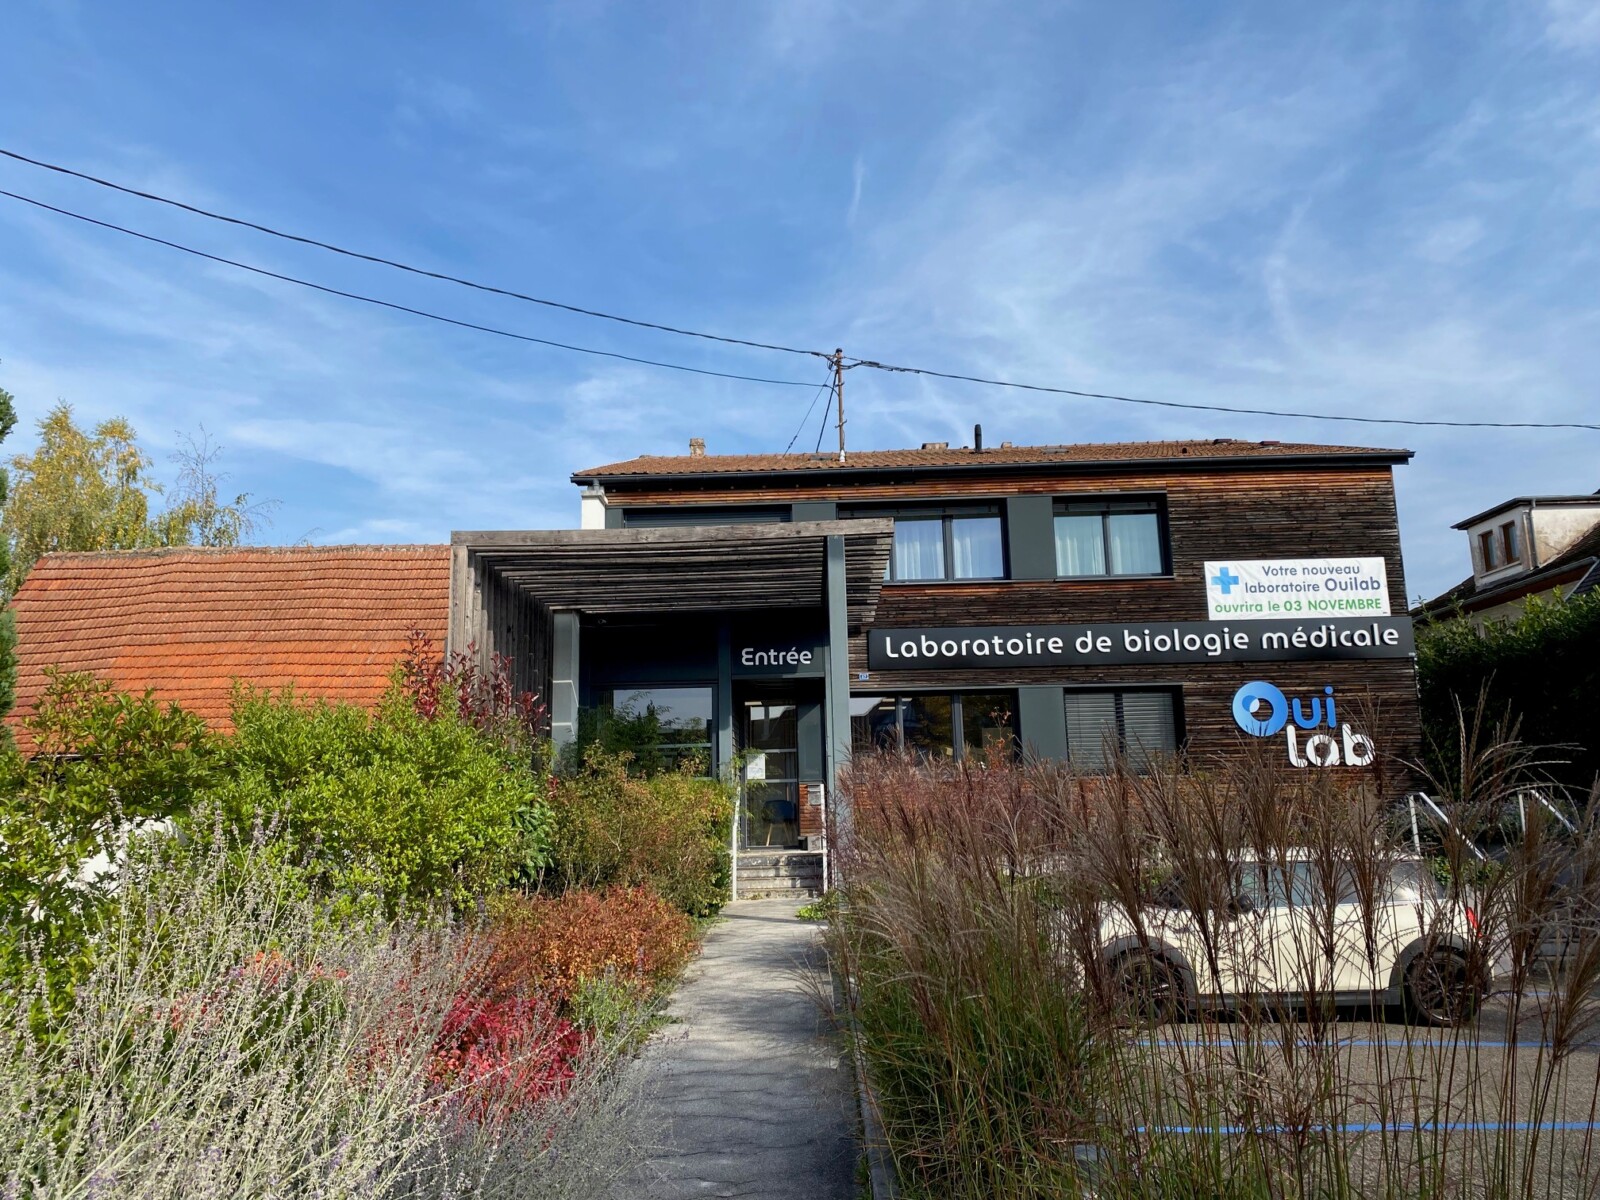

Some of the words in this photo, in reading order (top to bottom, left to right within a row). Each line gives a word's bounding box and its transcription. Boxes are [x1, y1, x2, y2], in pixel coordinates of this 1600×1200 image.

[1262, 566, 1298, 576] Votre
[1302, 565, 1360, 576] nouveau
[1245, 582, 1320, 594] laboratoire
[1324, 577, 1381, 592] Ouilab
[1214, 601, 1263, 613] ouvrira
[1268, 601, 1280, 612] le
[1283, 600, 1303, 612] 03
[1308, 598, 1382, 610] NOVEMBRE
[885, 632, 1064, 658] Laboratoire
[1075, 630, 1112, 653] de
[1123, 627, 1250, 656] biologie
[1261, 623, 1399, 649] médicale
[741, 646, 812, 666] Entrée
[1232, 681, 1337, 737] Oui
[1286, 723, 1376, 768] lab
